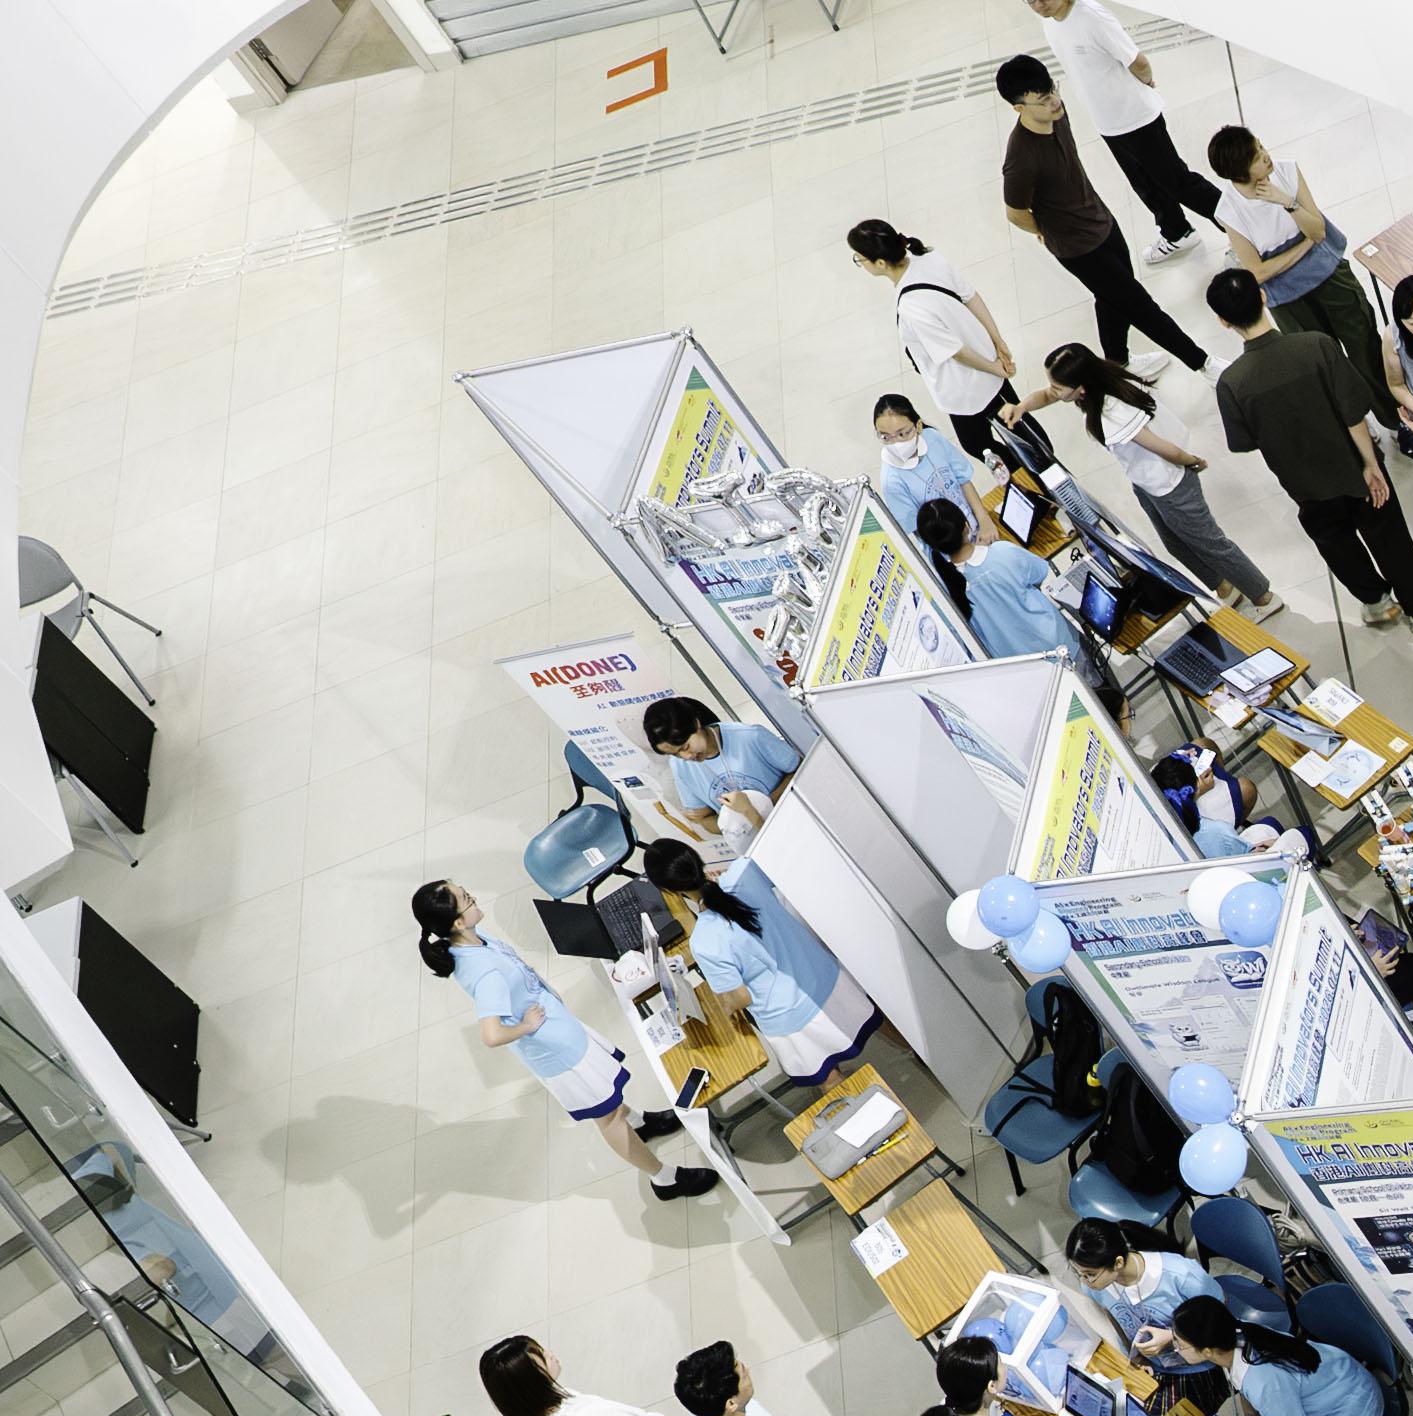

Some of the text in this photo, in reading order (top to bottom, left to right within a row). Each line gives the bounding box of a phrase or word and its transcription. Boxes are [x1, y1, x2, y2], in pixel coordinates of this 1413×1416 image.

[696, 398, 721, 453] Summit
[691, 563, 723, 583] HK
[851, 596, 879, 677] Innovators
[870, 541, 895, 600] Summit
[530, 654, 637, 687] AI(DONE)
[570, 679, 625, 699] 至夠醒
[1061, 785, 1089, 874] Innovators
[1080, 728, 1101, 790] Summit
[1069, 896, 1116, 907] Engineering
[1067, 910, 1199, 941] HK AI Innovat
[1293, 989, 1318, 1092] Innovators
[1308, 926, 1332, 995] Summit
[1296, 1145, 1333, 1165] HK
[1334, 1142, 1357, 1162] AI
